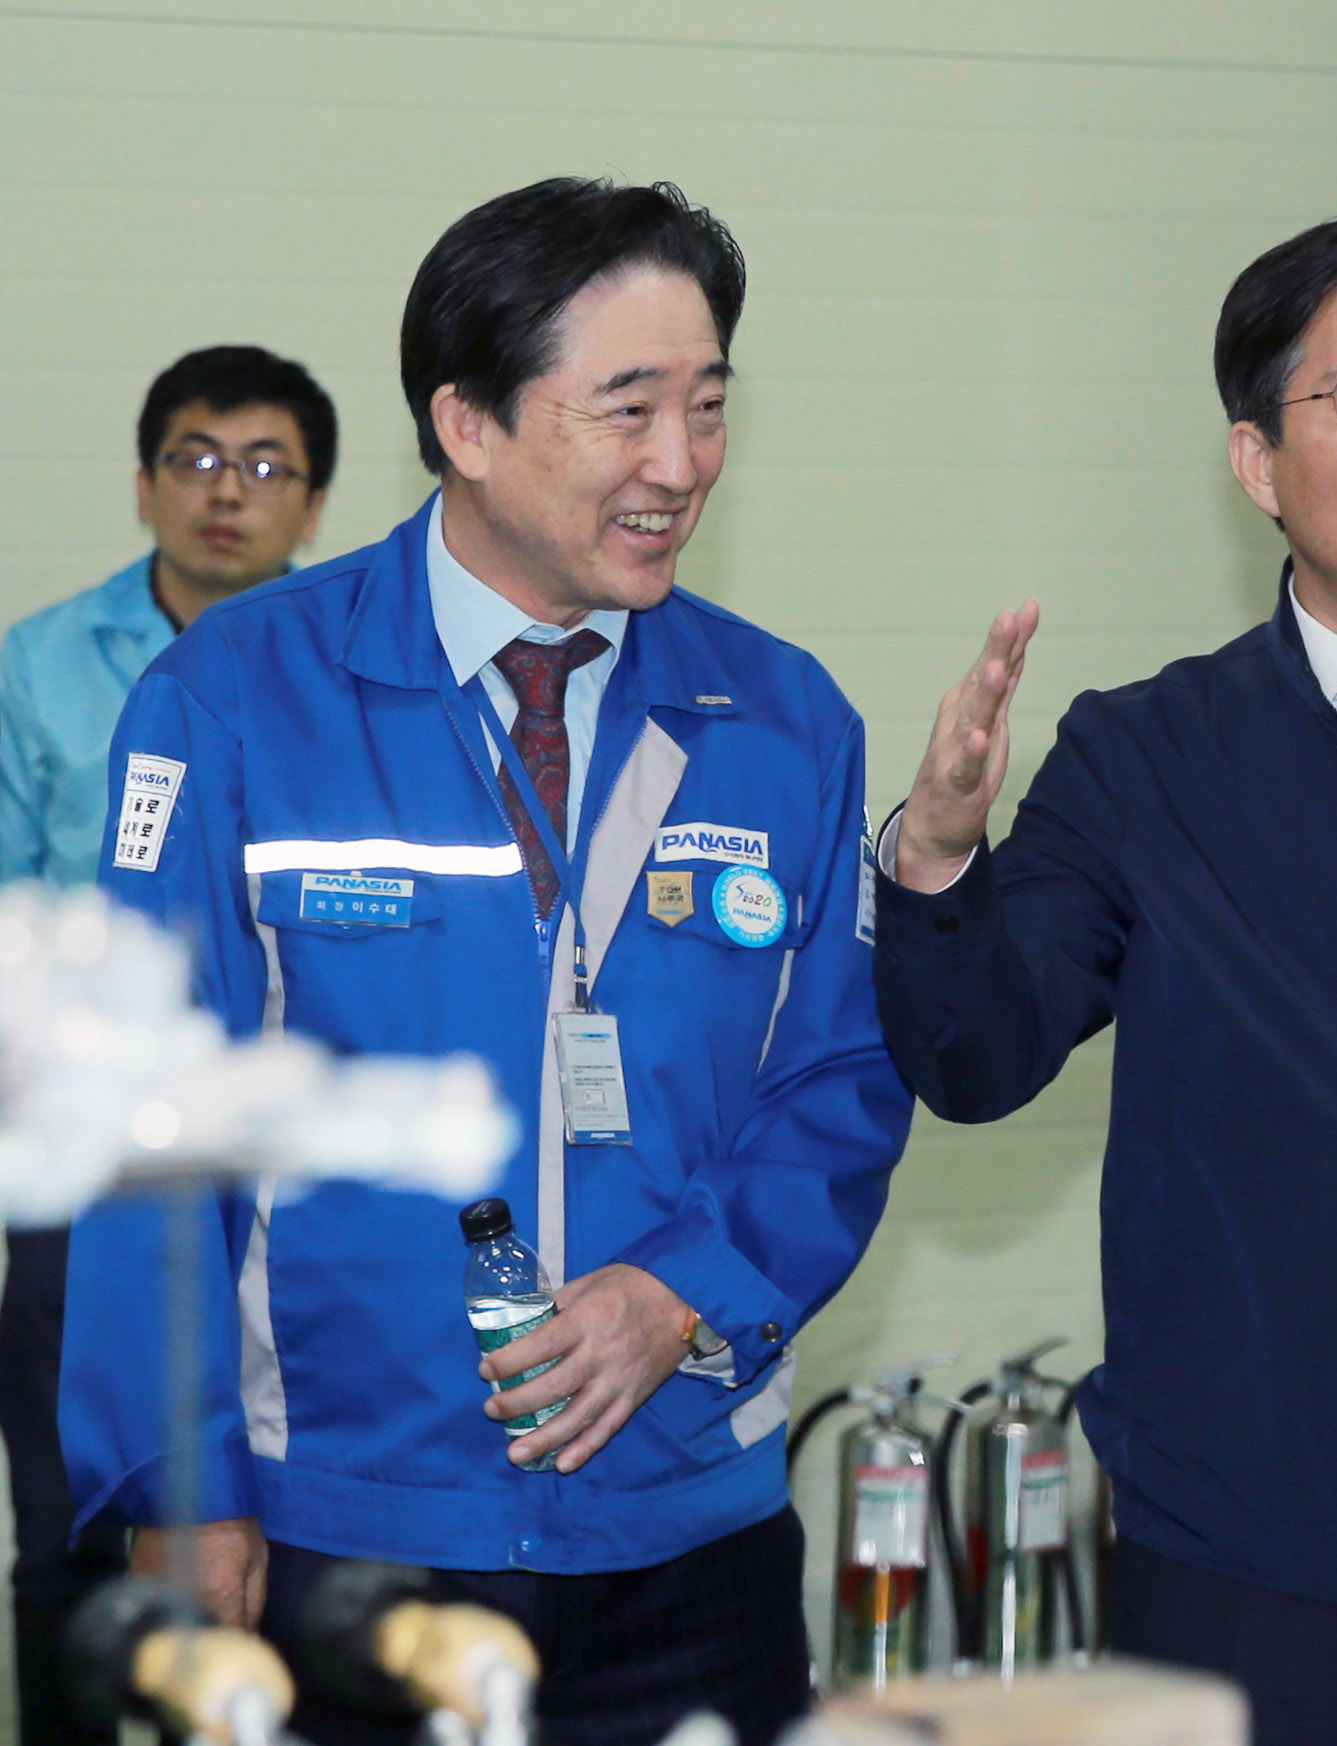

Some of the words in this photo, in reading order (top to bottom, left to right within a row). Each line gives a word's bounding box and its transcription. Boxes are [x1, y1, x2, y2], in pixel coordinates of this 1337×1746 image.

[661, 831, 763, 855] PANASIA
[315, 876, 402, 891] PANASIA
[733, 907, 772, 923] PANASIA
